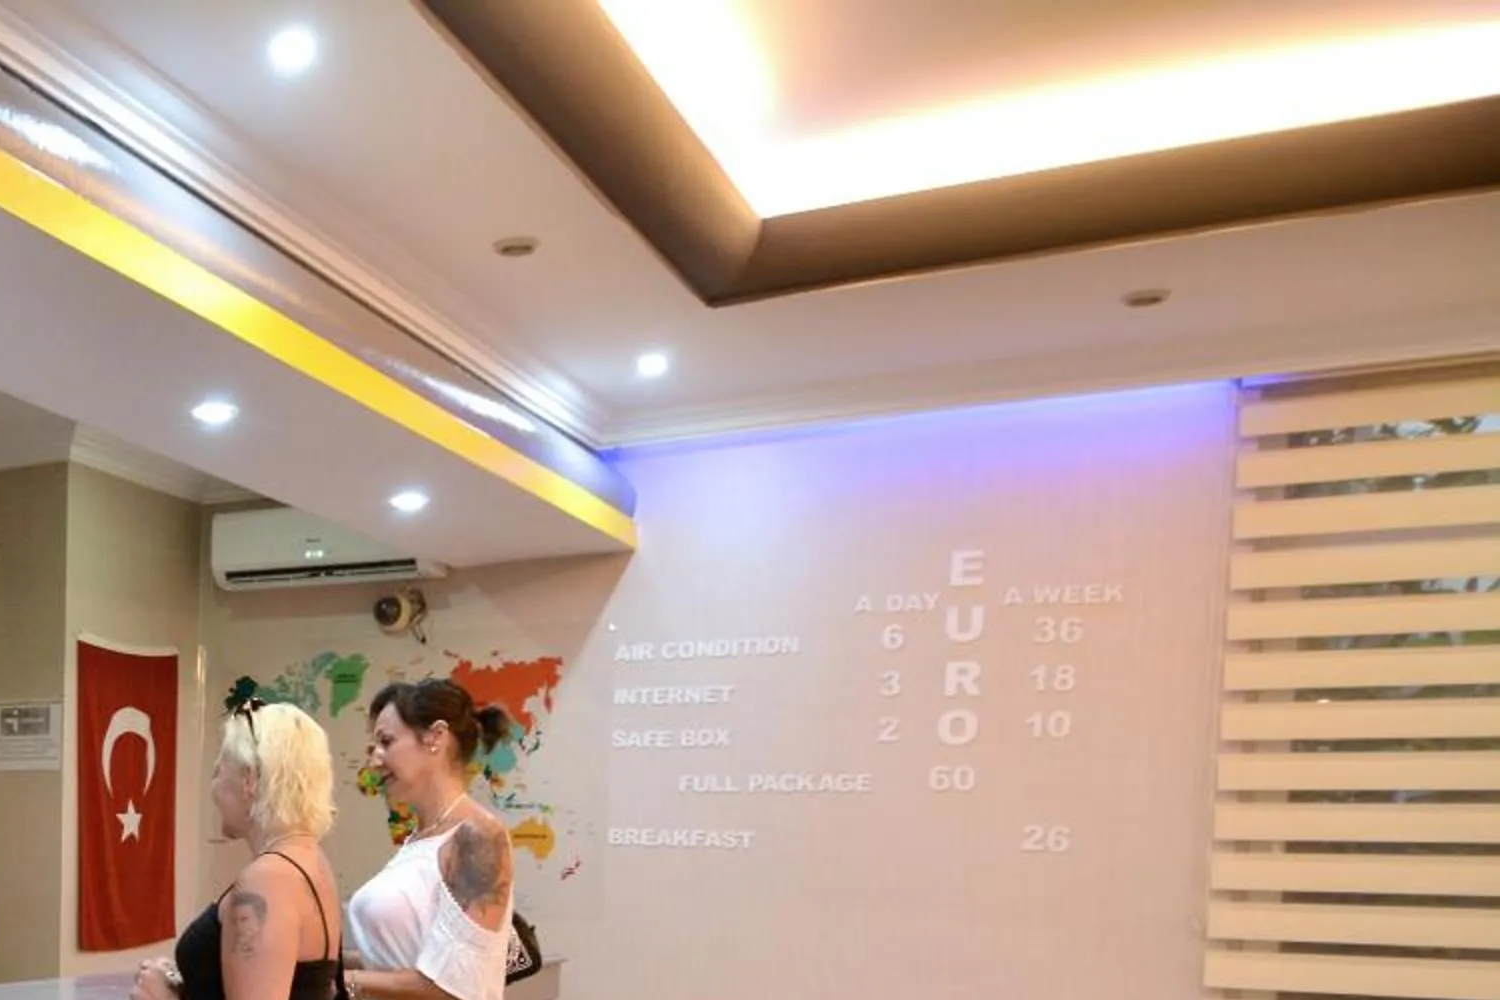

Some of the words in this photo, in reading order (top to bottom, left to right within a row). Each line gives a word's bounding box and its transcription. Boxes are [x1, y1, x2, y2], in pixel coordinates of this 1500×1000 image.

[854, 595, 873, 614] A
[886, 592, 941, 613] DAY
[1003, 586, 1024, 606] A
[1032, 583, 1125, 606] WEEK
[882, 625, 904, 650] 6
[1033, 617, 1084, 643] 36
[614, 642, 655, 662] AIR
[661, 636, 800, 660] CONDITION
[937, 549, 985, 746] EURO
[880, 671, 901, 697] 3
[1029, 665, 1076, 692] 18
[613, 685, 735, 705] INTERNET
[611, 729, 673, 748] SAFE
[680, 728, 731, 748] BOX
[877, 717, 900, 743] 2
[1025, 711, 1072, 739] 10
[678, 772, 739, 793] FULL
[748, 772, 872, 793] PACKAGE
[929, 765, 976, 791] 60
[607, 827, 755, 850] BREAKFAST
[1020, 825, 1070, 852] 26
